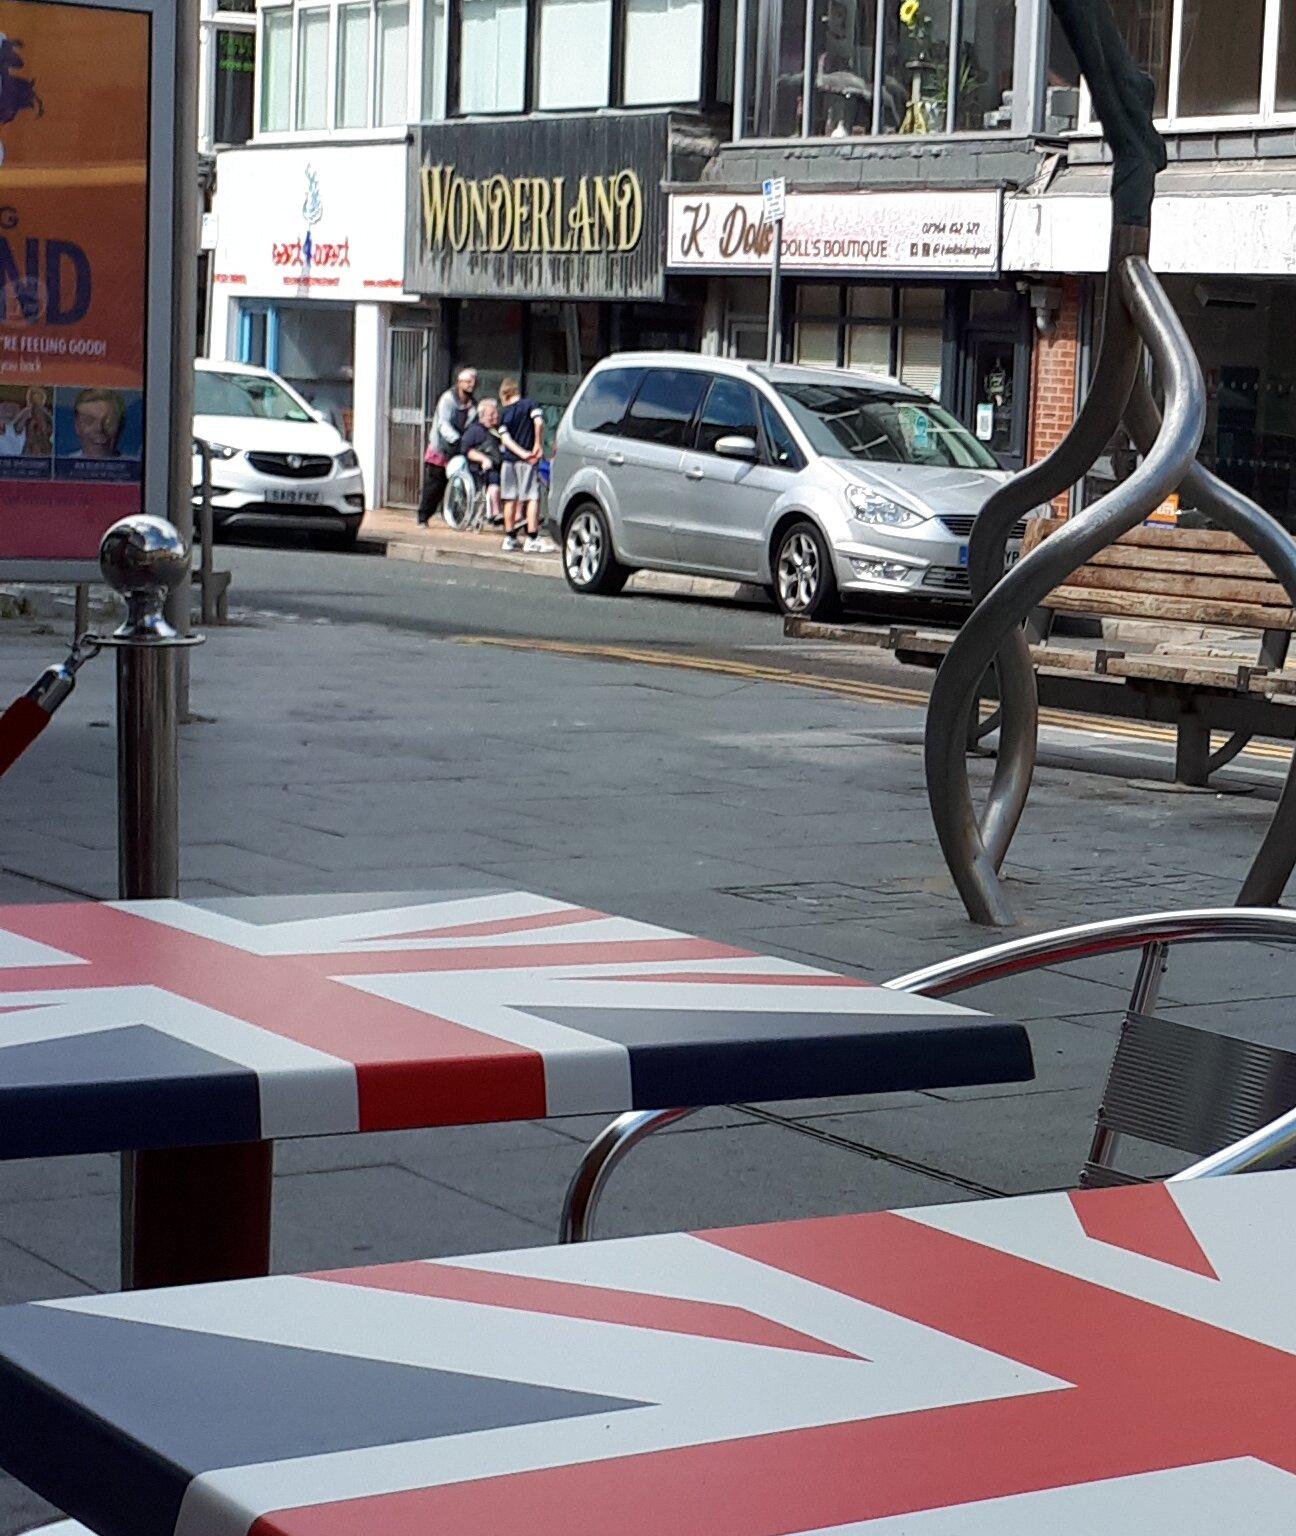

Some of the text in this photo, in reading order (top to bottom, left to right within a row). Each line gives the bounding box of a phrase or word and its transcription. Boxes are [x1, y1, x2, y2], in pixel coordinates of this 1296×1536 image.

[420, 164, 643, 252] WONDERLAND
[680, 202, 711, 258] K
[824, 239, 888, 261] BOUTIQUE
[20, 336, 67, 354] FEELING
[68, 339, 107, 356] GOOD!
